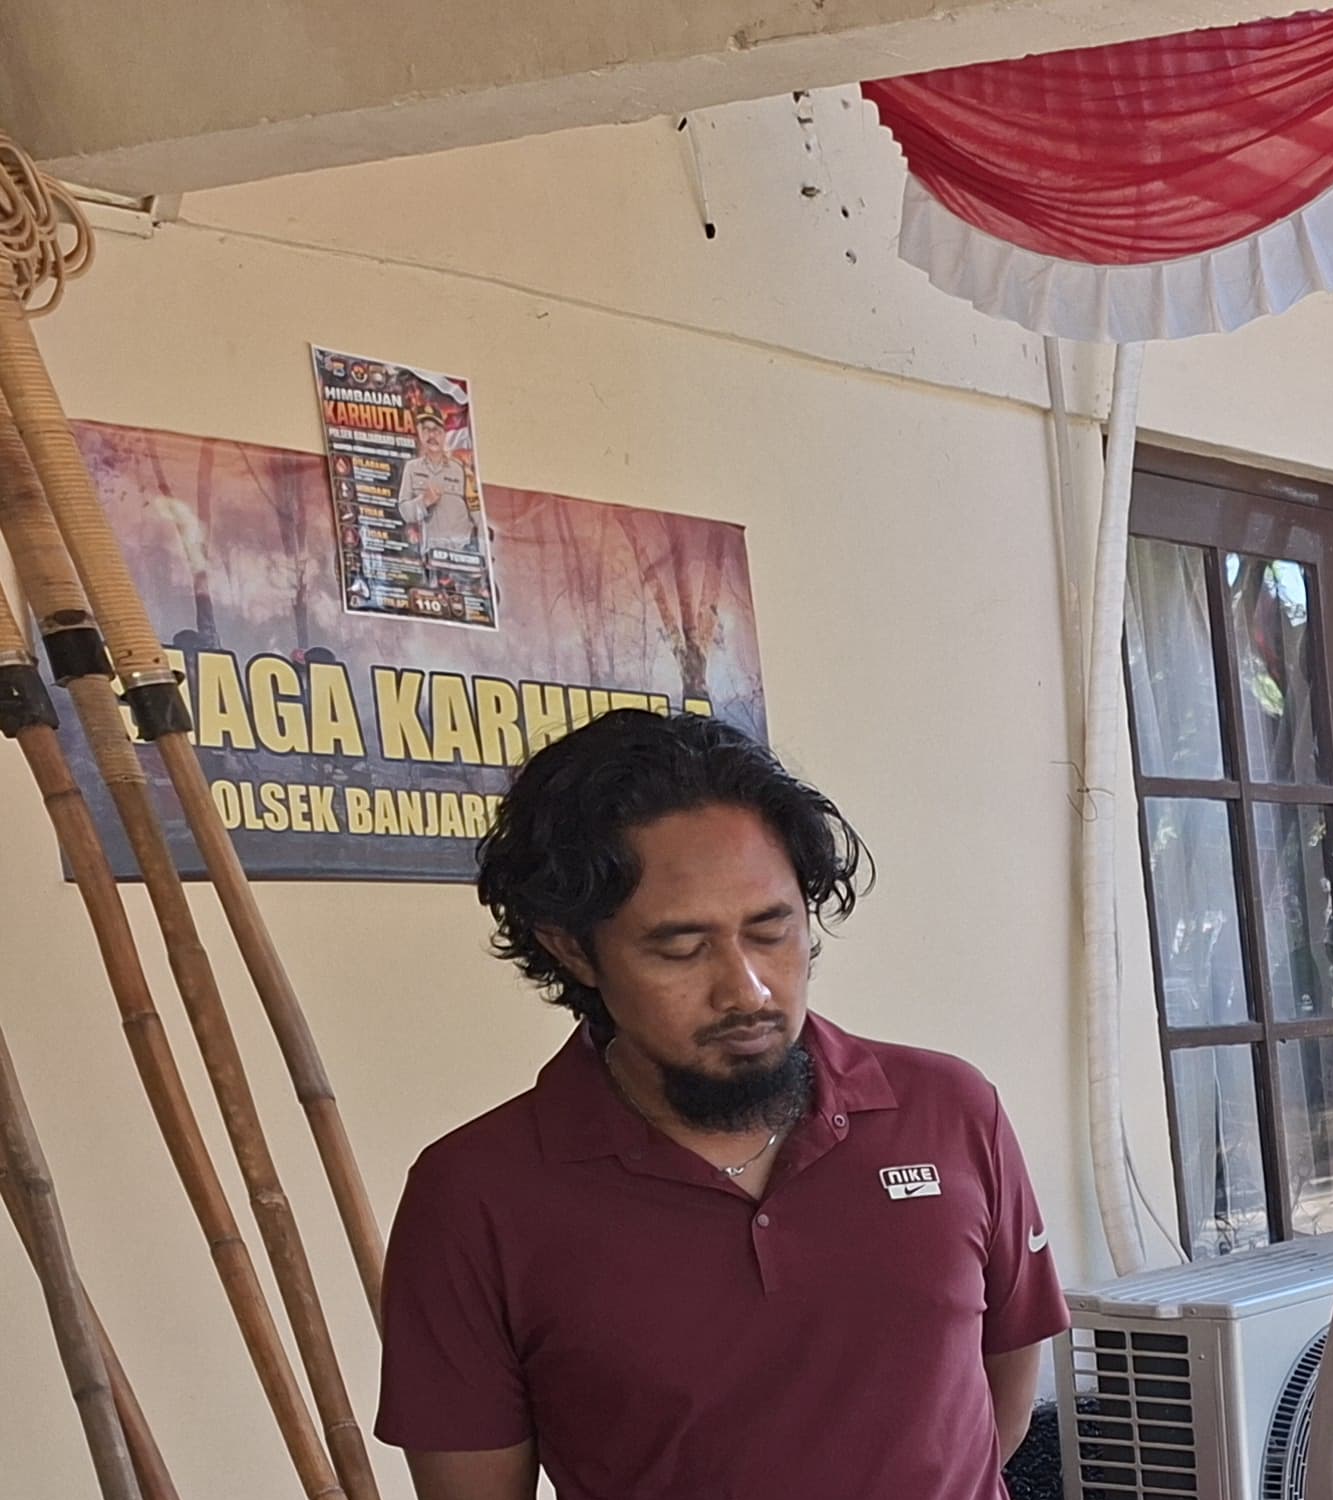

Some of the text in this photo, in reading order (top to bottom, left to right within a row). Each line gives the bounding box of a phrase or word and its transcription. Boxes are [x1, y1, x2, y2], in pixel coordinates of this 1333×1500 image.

[324, 385, 403, 408] HIMBAUAN
[324, 400, 416, 434] KARHUTLA
[415, 598, 441, 612] 110
[373, 667, 712, 767] KARH
[211, 780, 503, 839] OLSEK BANJAR
[888, 1168, 933, 1184] NIKE
